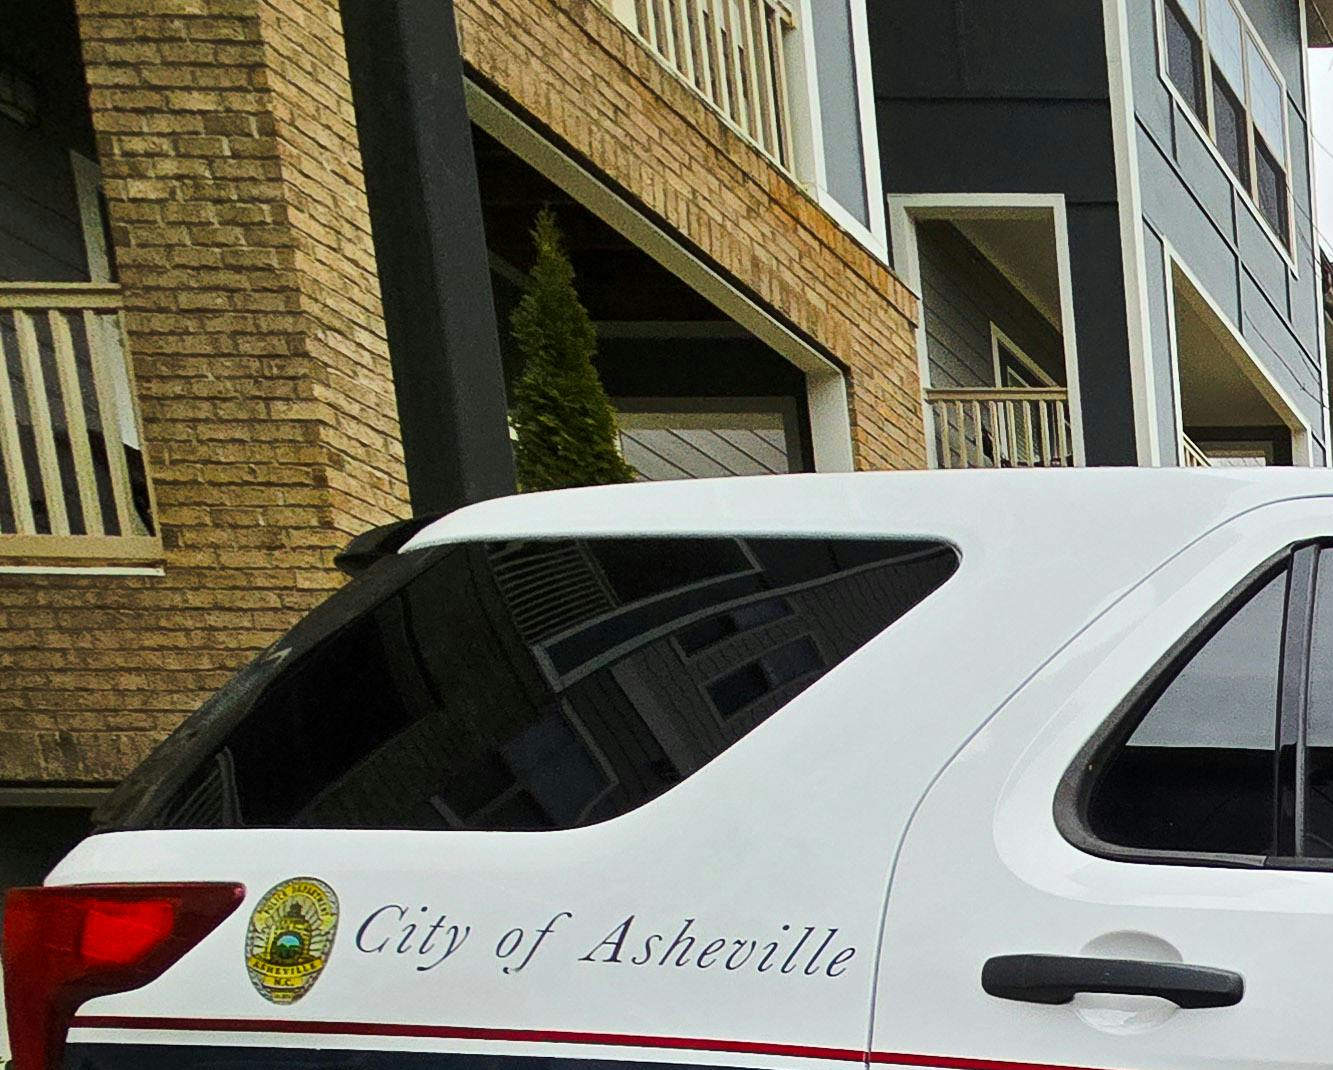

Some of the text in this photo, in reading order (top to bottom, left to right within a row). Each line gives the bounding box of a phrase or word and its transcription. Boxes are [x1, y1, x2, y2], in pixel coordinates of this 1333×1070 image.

[355, 904, 856, 977] City of Asheville
[252, 960, 316, 976] ASHEVILLE
